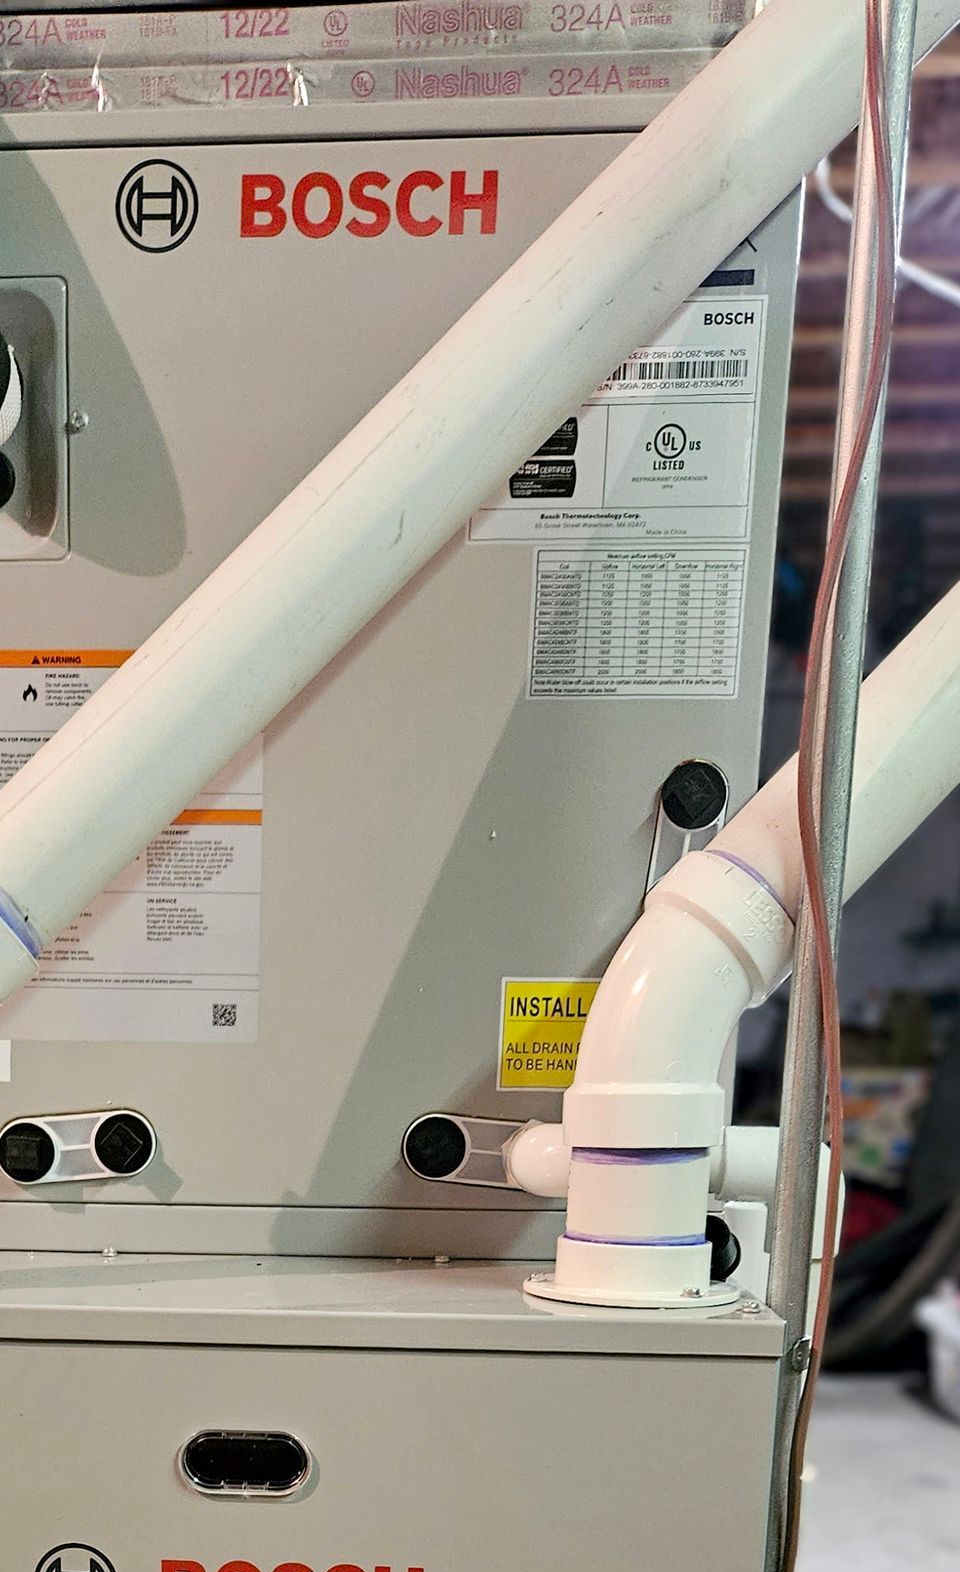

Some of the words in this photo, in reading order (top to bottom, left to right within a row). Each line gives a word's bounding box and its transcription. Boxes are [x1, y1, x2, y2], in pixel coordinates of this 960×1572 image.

[220, 8, 289, 38] 12/22
[394, 3, 524, 36] Nashua
[550, 3, 626, 33] 324A
[629, 14, 673, 27] WEATHER
[220, 67, 289, 100] 12/22
[394, 65, 521, 99] Nashua
[548, 65, 625, 97] 324A
[628, 77, 670, 90] WEATHER
[241, 169, 498, 239] BOSCH
[704, 312, 755, 326] BOSCH
[689, 441, 702, 451] US
[653, 460, 685, 471] LISTED
[42, 655, 81, 664] WARNING
[510, 996, 588, 1017] INSTALL
[506, 1042, 529, 1054] ALL
[532, 1042, 573, 1054] DRAIN
[506, 1058, 523, 1071] TO
[526, 1059, 543, 1071] BE
